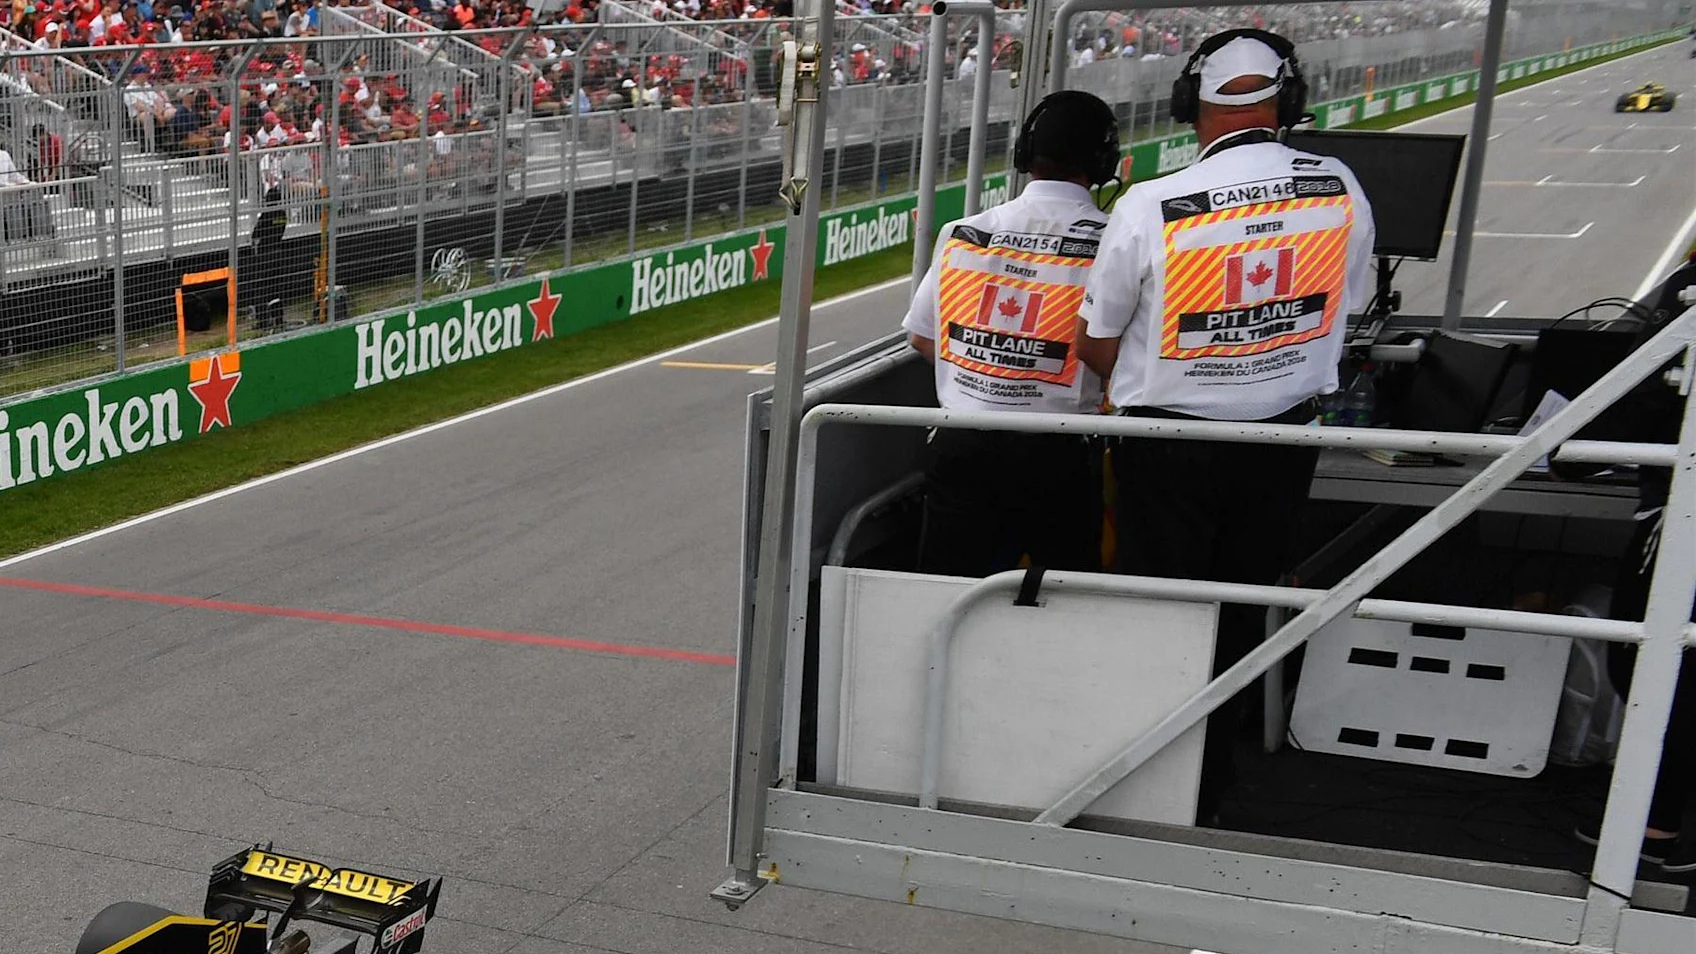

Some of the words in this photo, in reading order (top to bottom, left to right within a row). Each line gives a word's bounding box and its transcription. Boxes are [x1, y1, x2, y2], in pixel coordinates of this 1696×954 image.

[1212, 182, 1294, 206] CAN2148
[1296, 180, 1341, 194] 2018
[824, 205, 908, 266] Heineken
[1245, 220, 1284, 236] STARTER
[990, 233, 1059, 251] CAN2154
[629, 242, 747, 315] Heineken
[1004, 263, 1037, 278] STARTER
[1206, 311, 1244, 330] PIT
[1247, 300, 1304, 324] LANE
[354, 298, 523, 390] Heineken
[962, 328, 989, 347] PIT
[991, 334, 1046, 356] LANE
[1210, 330, 1244, 343] ALL
[1247, 320, 1296, 340] TIMES
[964, 347, 988, 361] ALL
[990, 350, 1037, 369] TIMES
[257, 855, 406, 900] RENAULT
